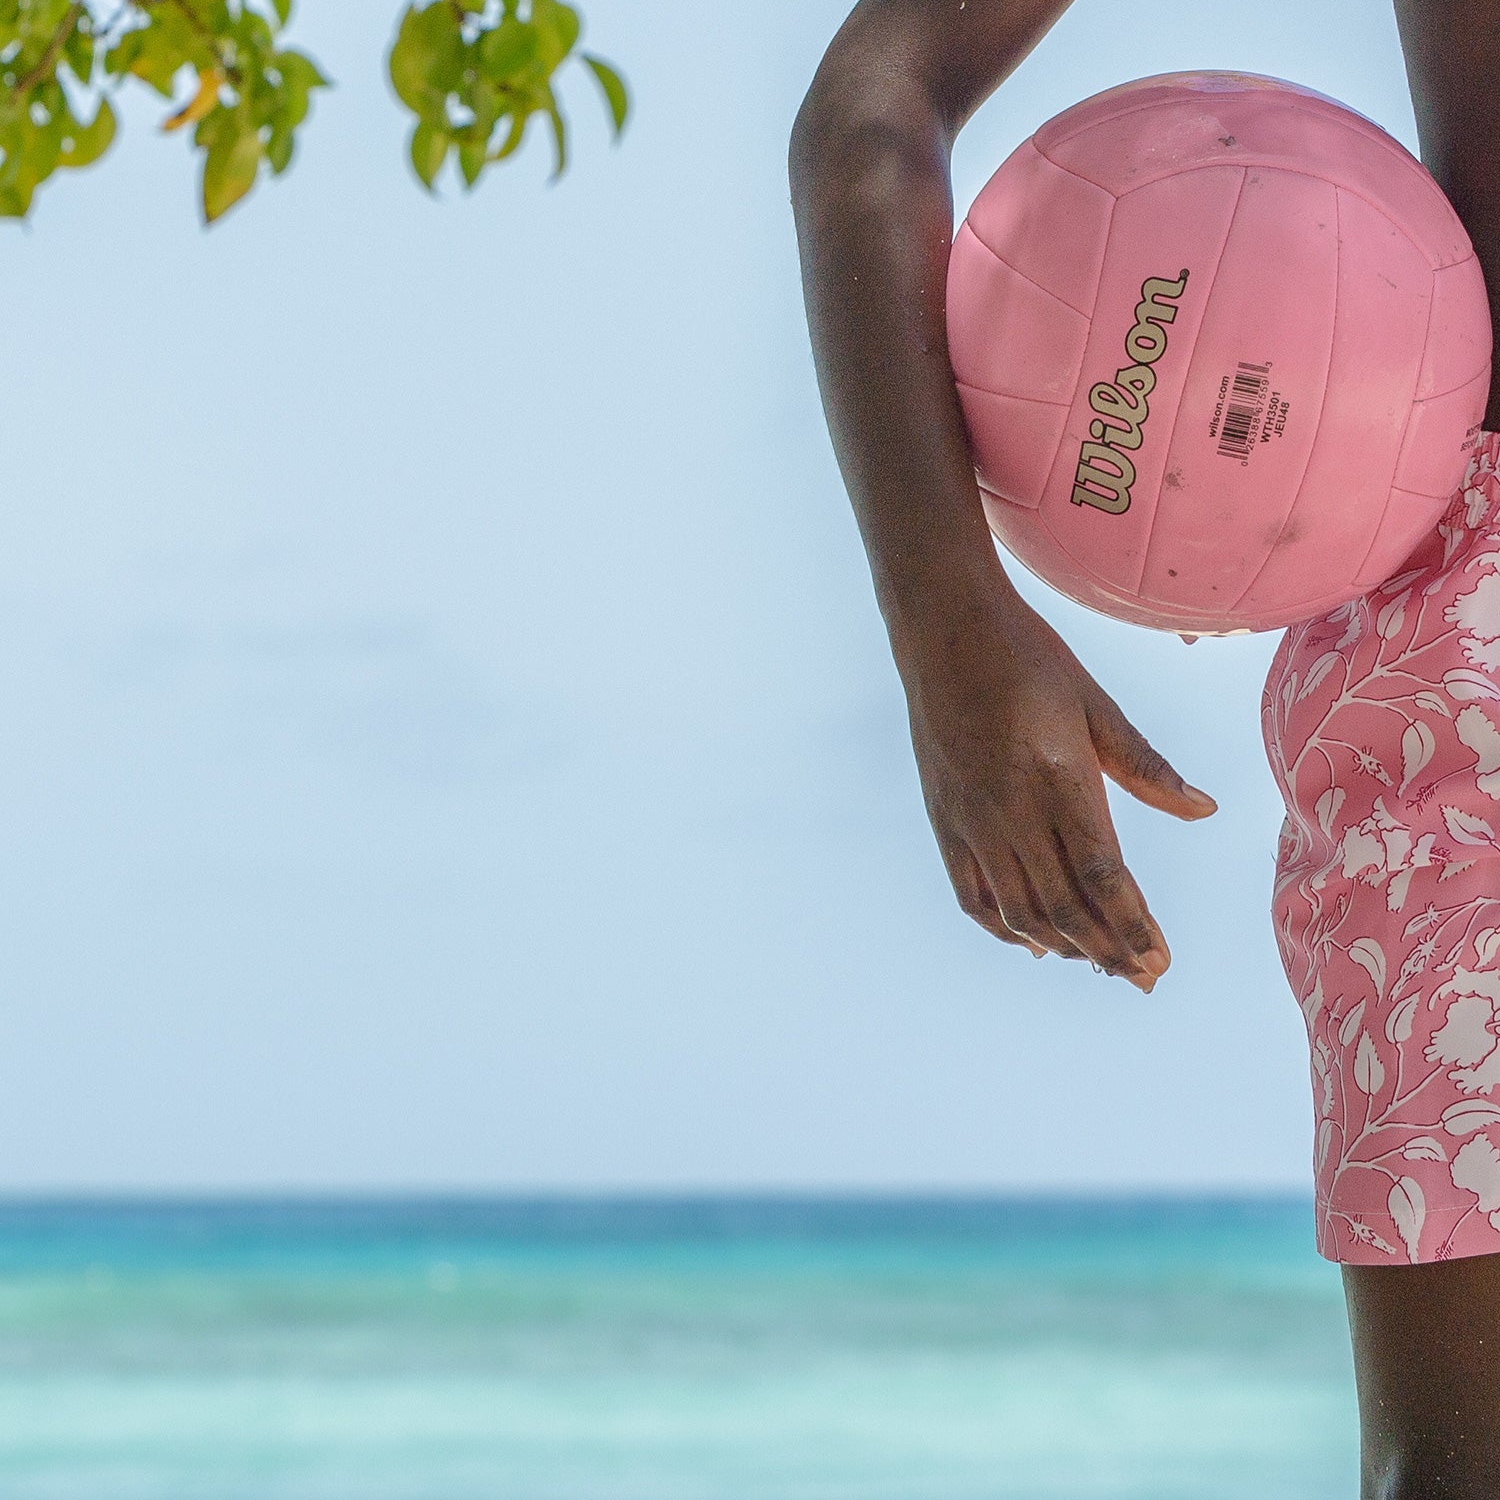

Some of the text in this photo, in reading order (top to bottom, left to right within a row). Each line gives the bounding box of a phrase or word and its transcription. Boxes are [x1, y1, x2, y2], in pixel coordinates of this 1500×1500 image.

[1208, 375, 1230, 438] wilson.com
[1260, 391, 1281, 443] WTH3501
[1274, 401, 1290, 438] JEU48
[1246, 417, 1261, 451] 26388
